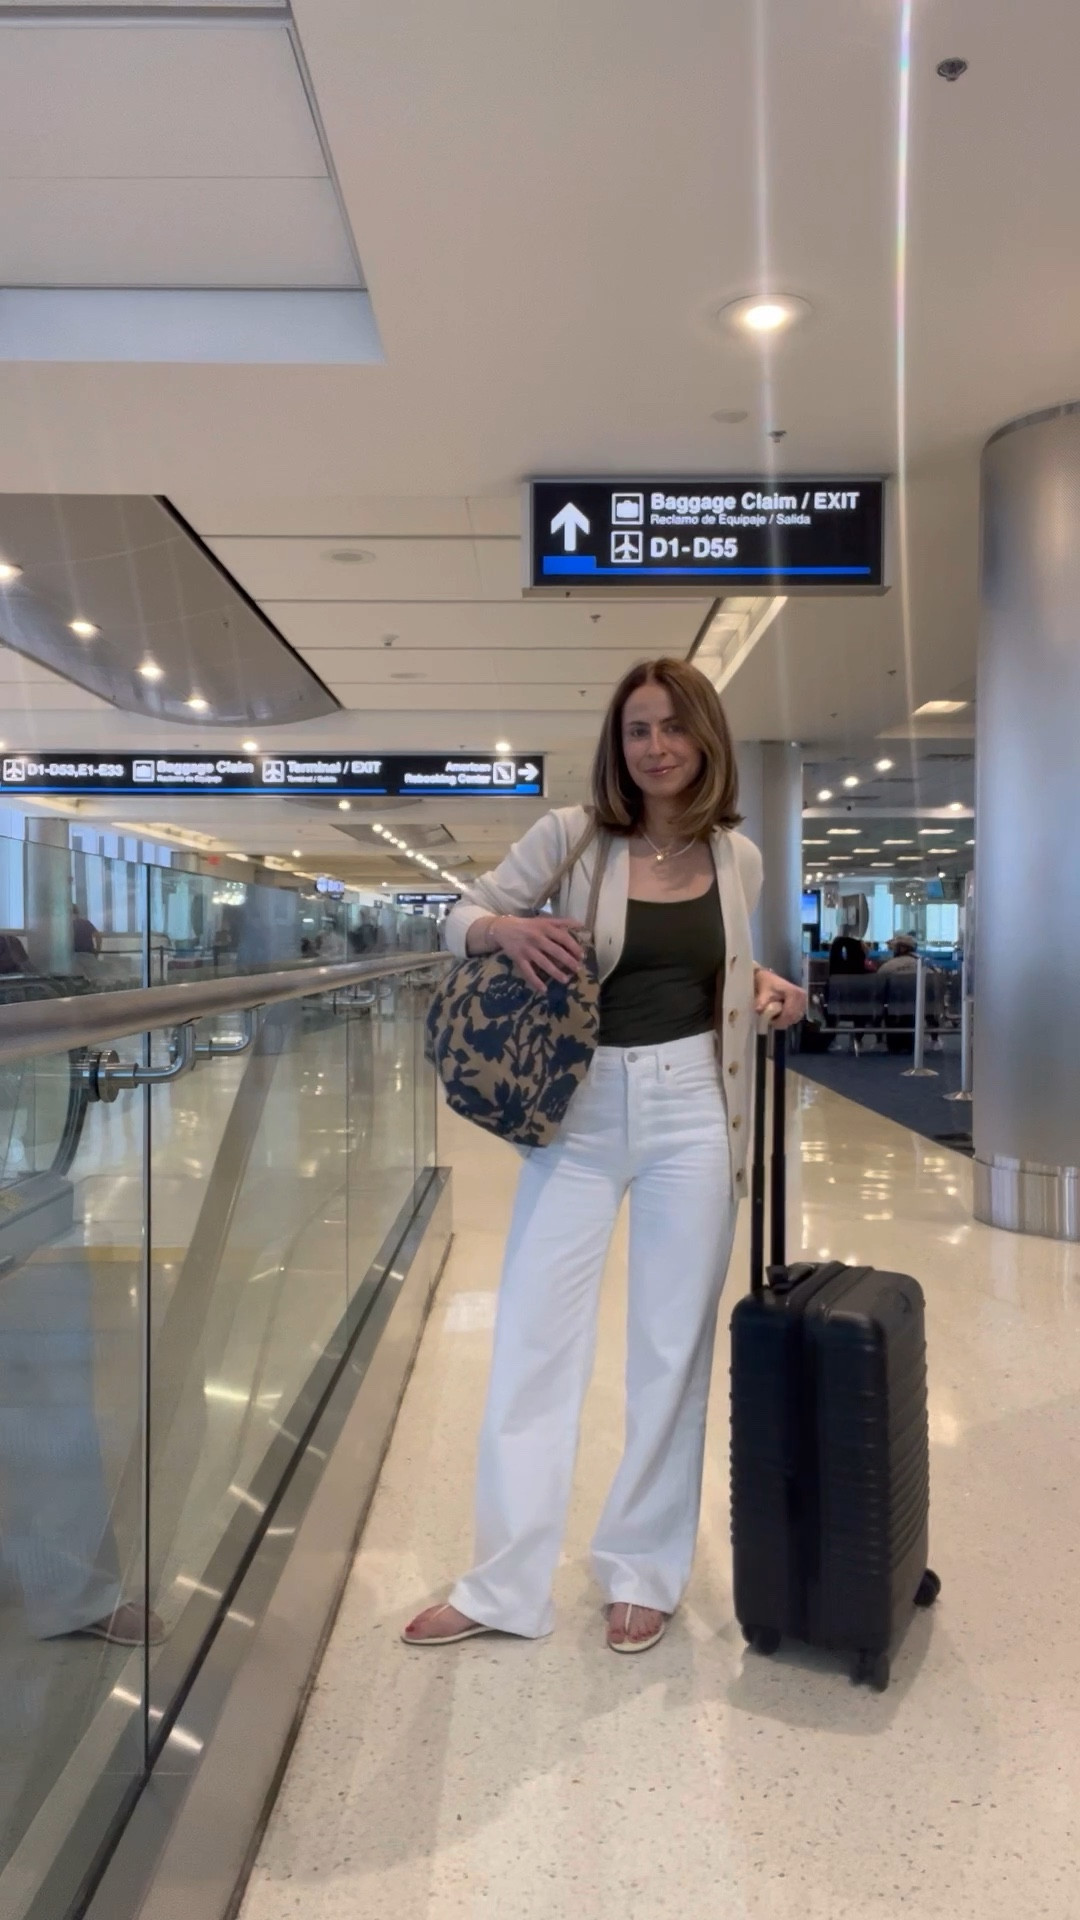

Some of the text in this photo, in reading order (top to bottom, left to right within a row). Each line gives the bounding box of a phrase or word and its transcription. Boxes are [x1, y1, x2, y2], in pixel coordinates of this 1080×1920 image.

[650, 492, 860, 514] Baggage Claim / EXIT
[650, 513, 812, 527] Reclamo de Equipaje / Salida
[650, 537, 738, 558] D1-D55
[157, 760, 254, 776] Baggage Claim
[287, 760, 382, 775] Terminal / EXIT
